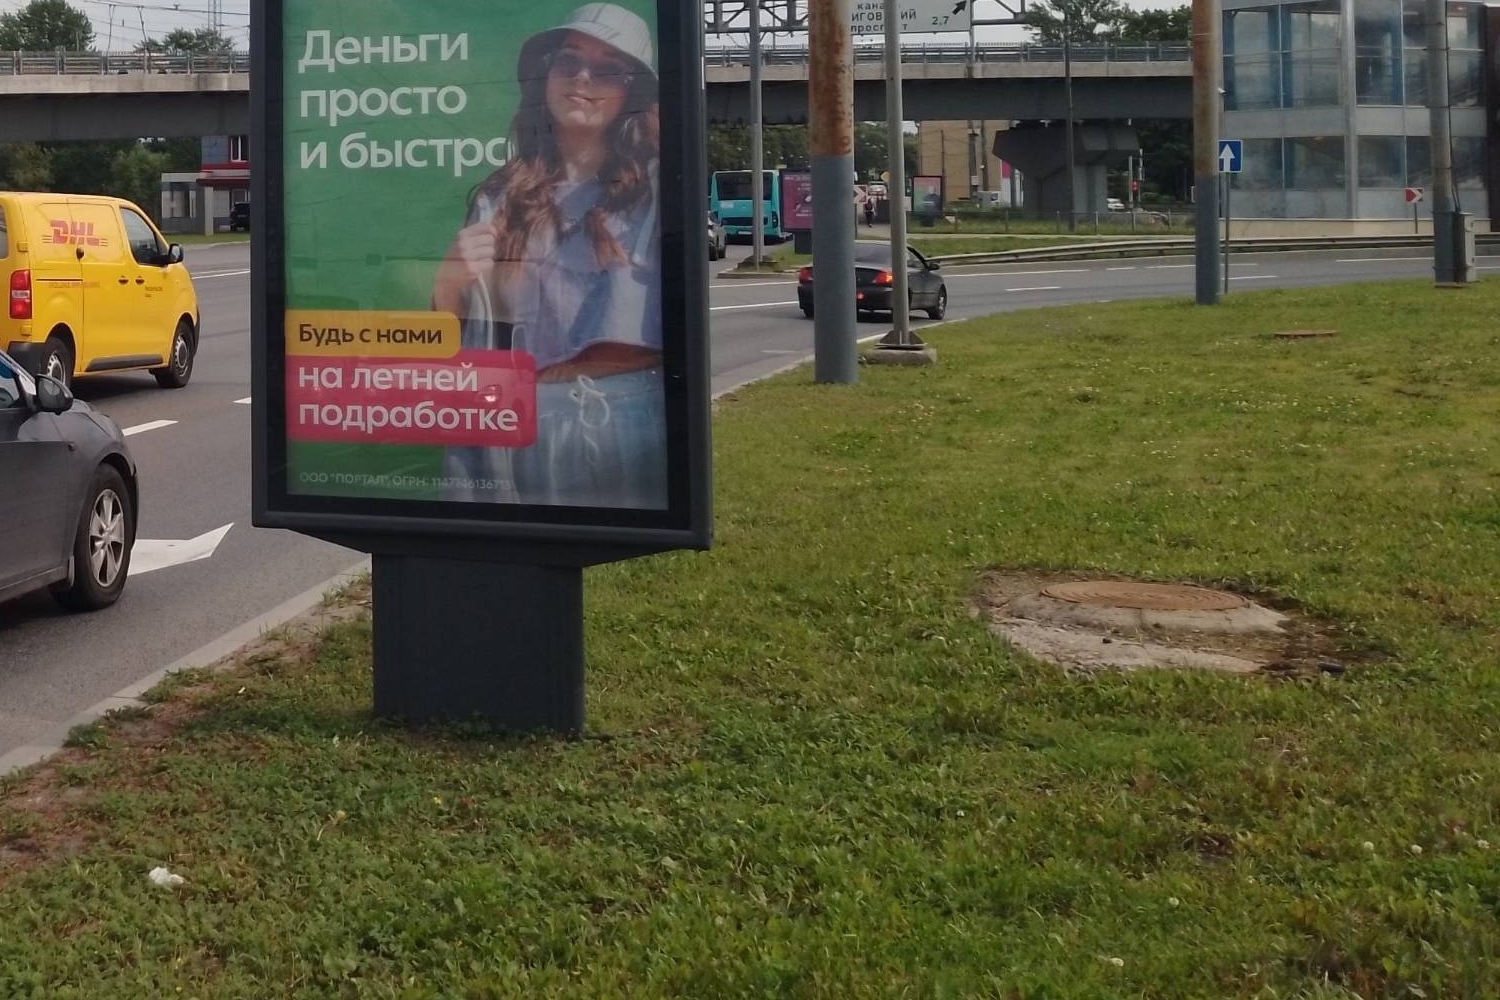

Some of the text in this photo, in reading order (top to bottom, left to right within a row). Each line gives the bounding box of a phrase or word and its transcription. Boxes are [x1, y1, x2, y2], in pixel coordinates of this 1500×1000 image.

[851, 9, 917, 21] ИГОВИЙ
[932, 16, 949, 25] 2,7
[299, 30, 468, 73] Деньги
[300, 85, 467, 126] просто
[300, 140, 327, 169] и
[50, 220, 100, 246] DHL
[300, 324, 442, 345] Будь с нами
[299, 362, 479, 393] на летней
[300, 401, 518, 433] подработке
[300, 471, 329, 483] ООО
[392, 475, 429, 487] ОГРН:
